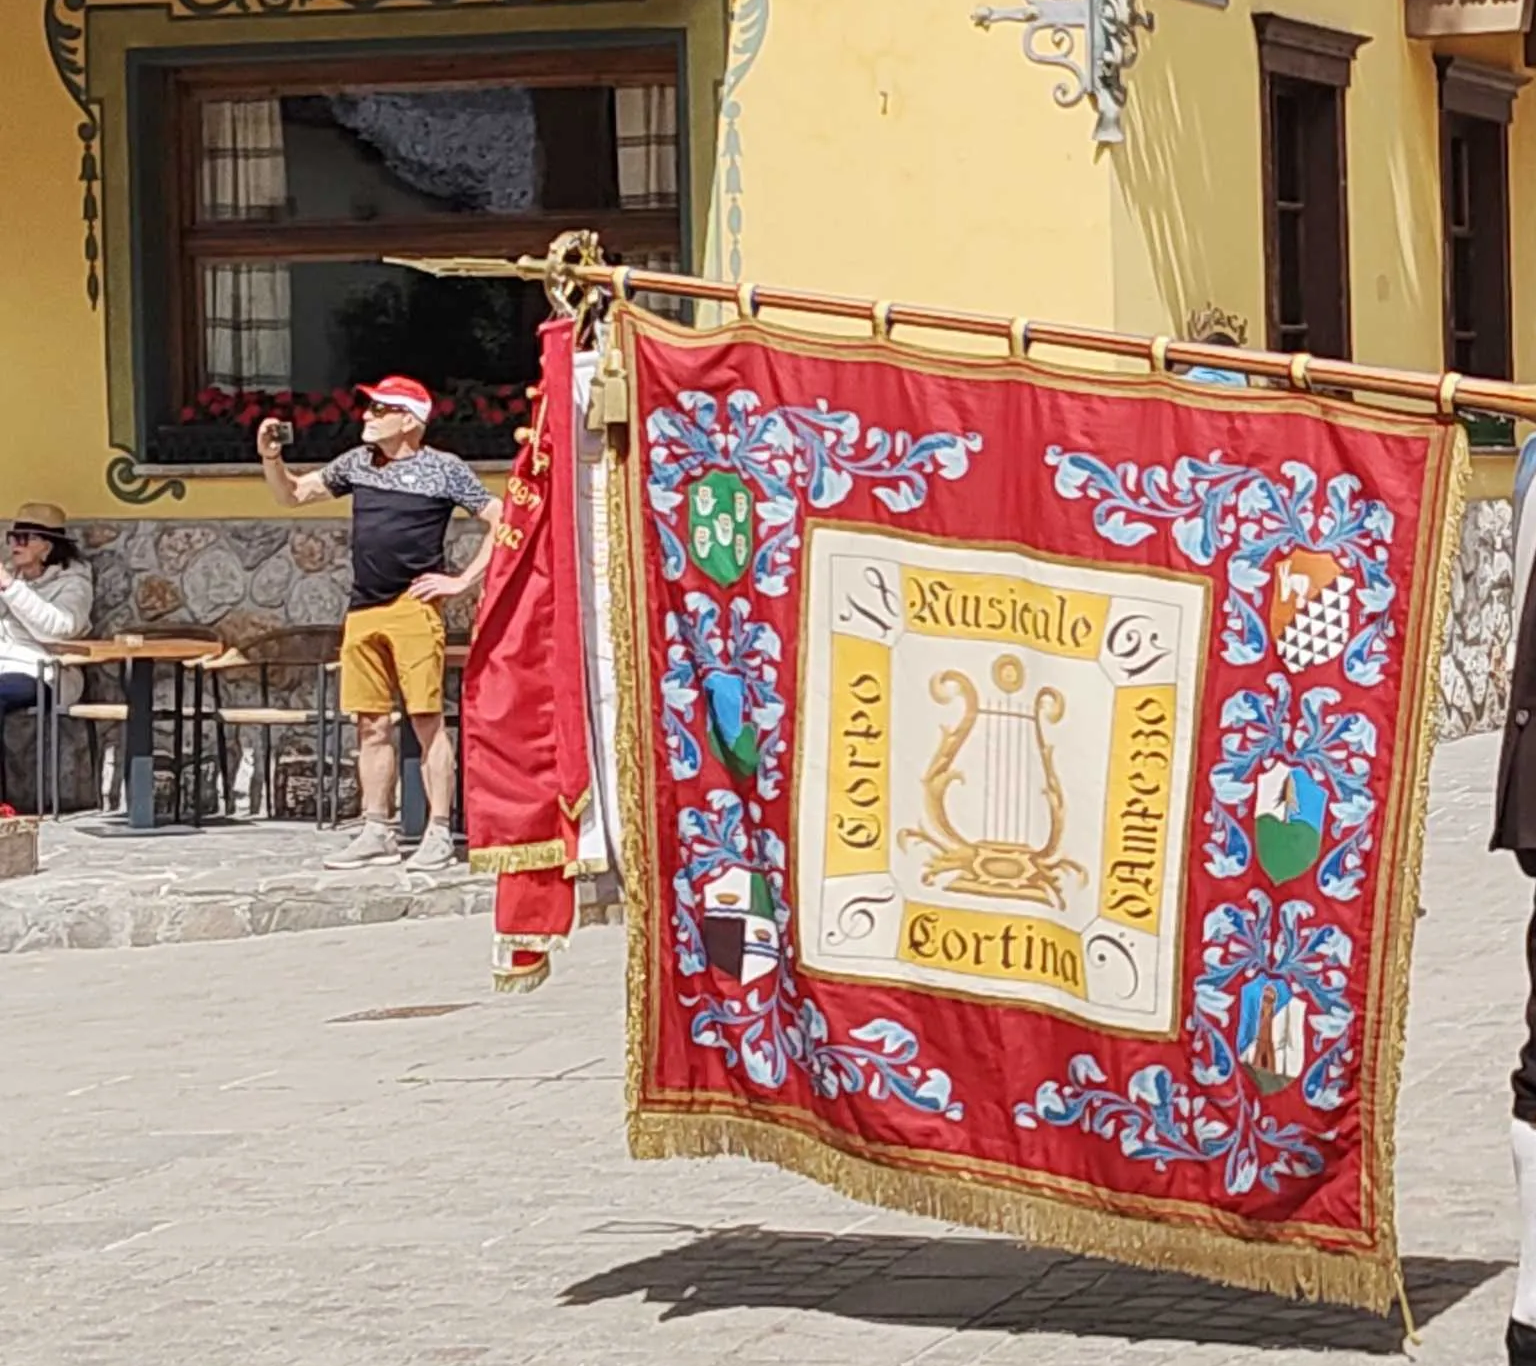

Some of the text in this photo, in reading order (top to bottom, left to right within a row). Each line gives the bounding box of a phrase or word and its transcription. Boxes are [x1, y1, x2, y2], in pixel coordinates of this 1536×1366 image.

[908, 577, 1093, 649] Musicale
[837, 672, 883, 852] Corpo
[1107, 697, 1170, 920] d'Ampezzo
[907, 911, 1082, 987] Cortina
